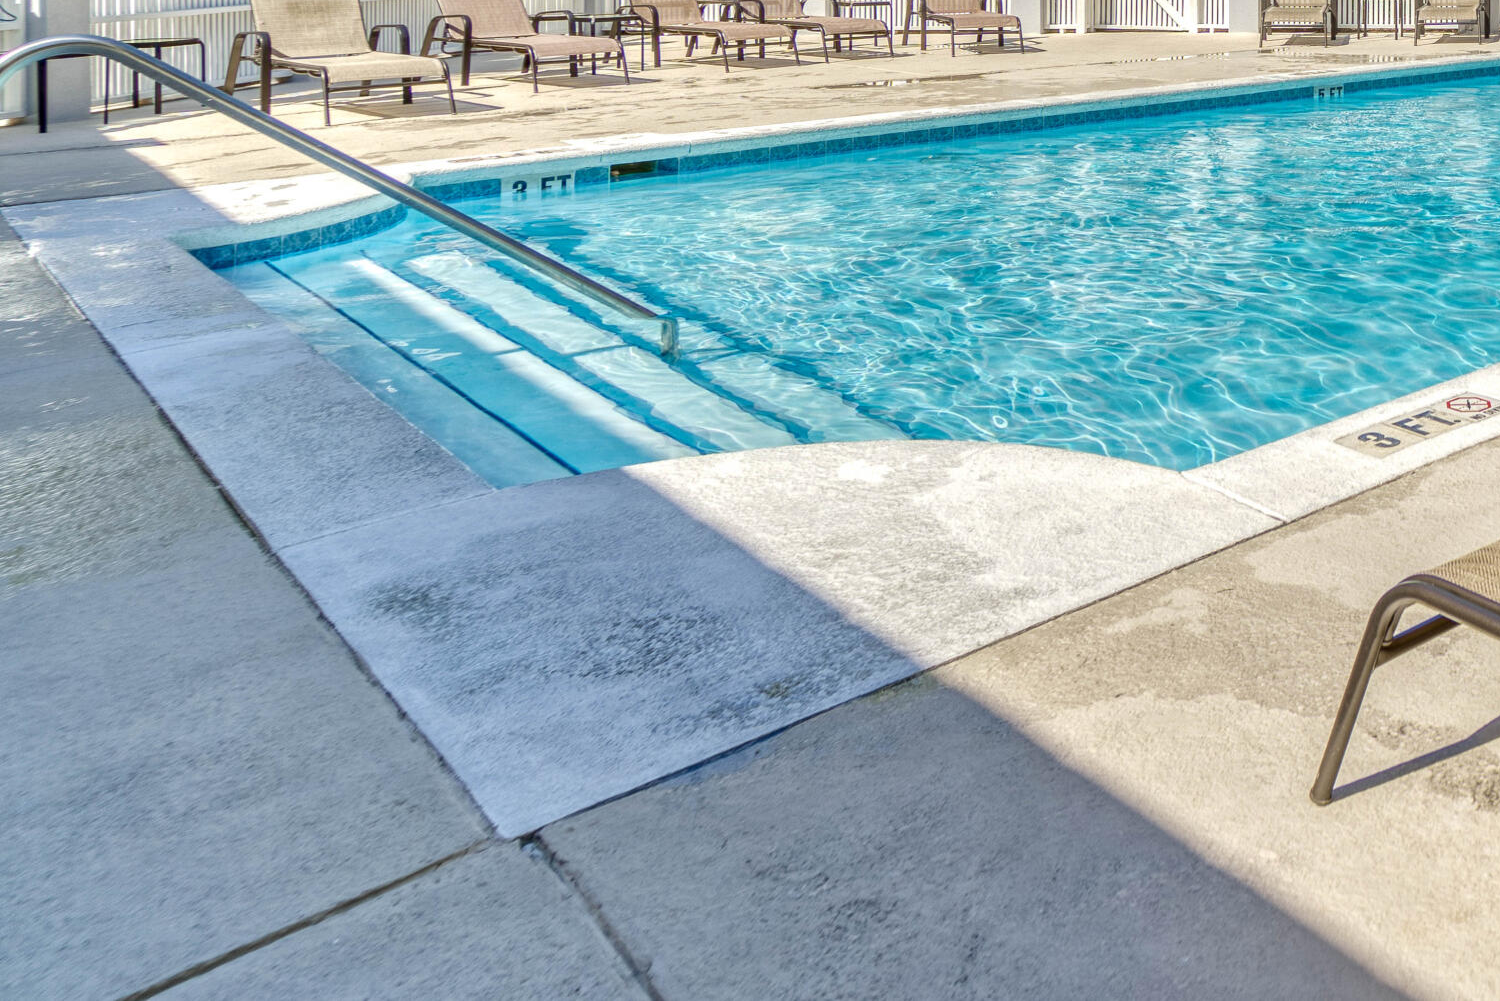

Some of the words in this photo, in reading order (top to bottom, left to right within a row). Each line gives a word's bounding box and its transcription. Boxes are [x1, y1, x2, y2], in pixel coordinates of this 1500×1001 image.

[1330, 86, 1342, 97] FT
[541, 174, 572, 191] FT
[1357, 431, 1401, 448] 3
[1391, 410, 1462, 436] FT.
